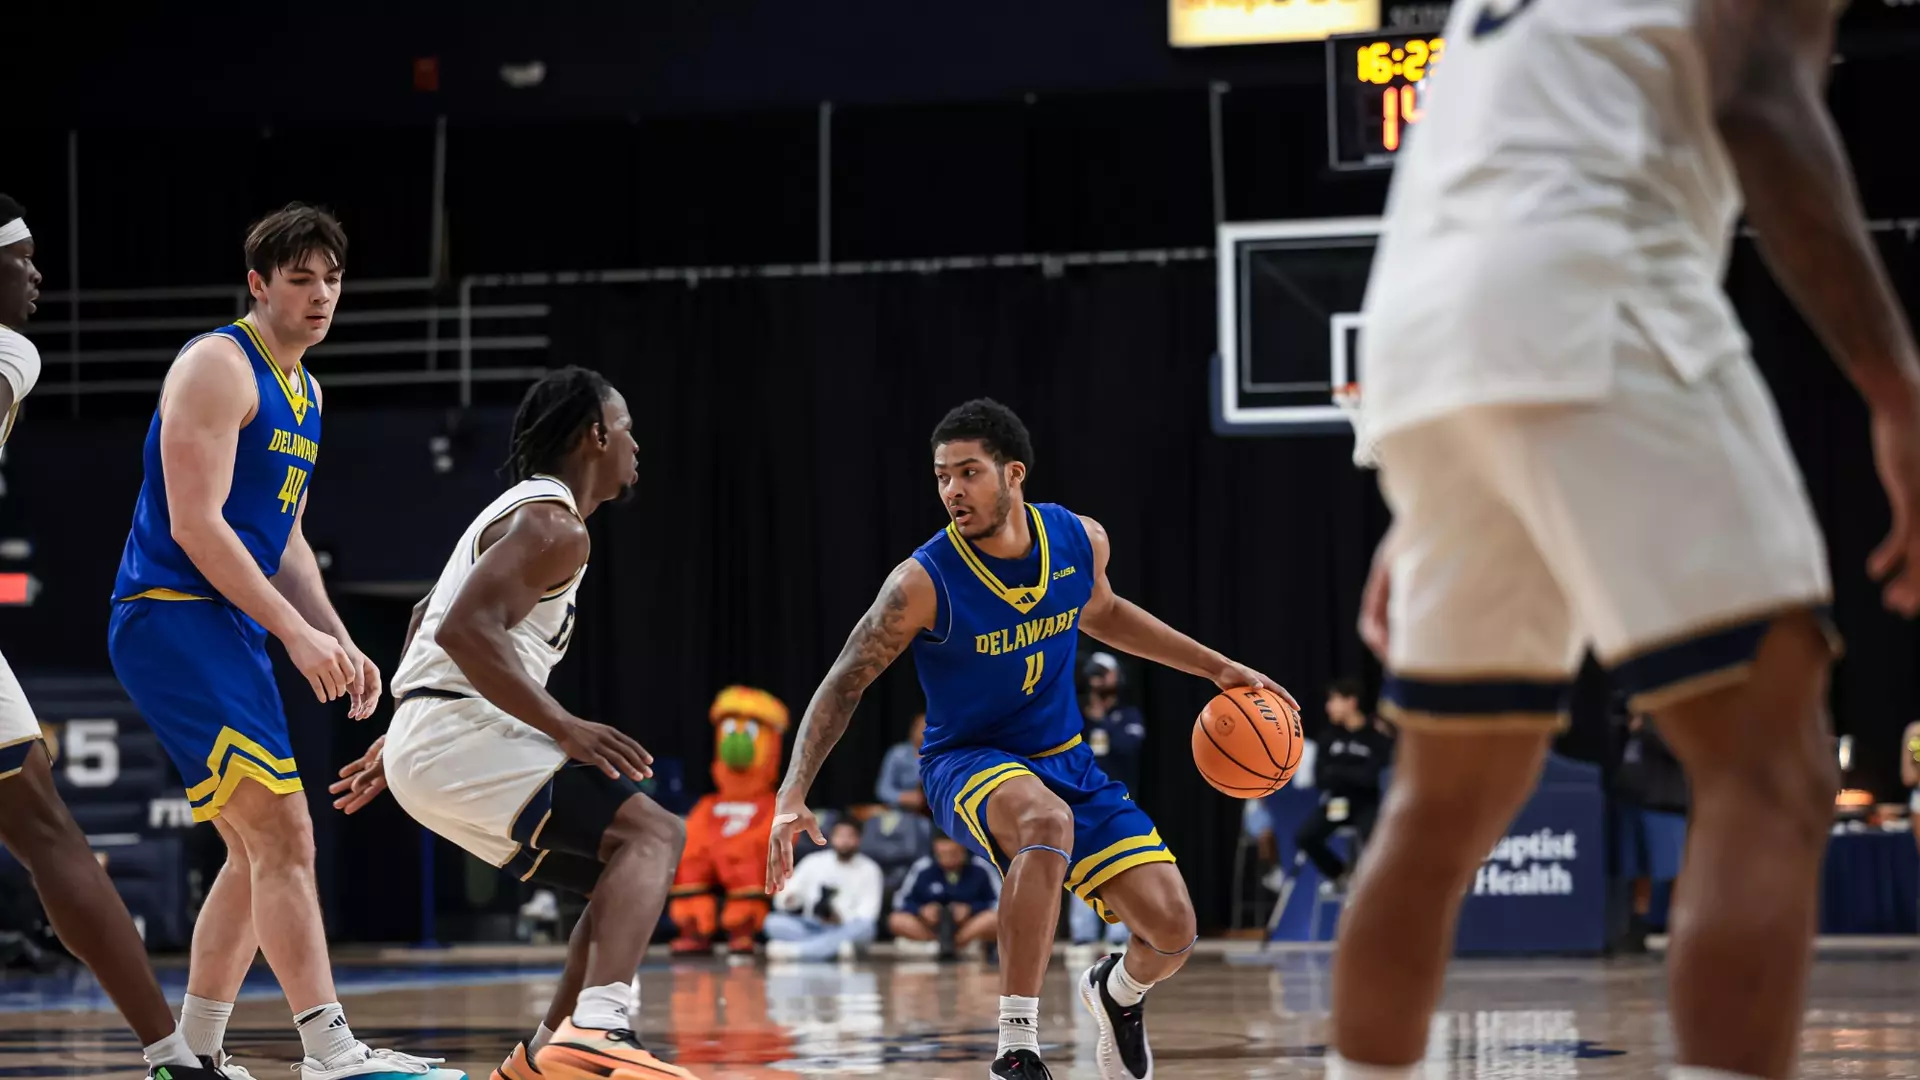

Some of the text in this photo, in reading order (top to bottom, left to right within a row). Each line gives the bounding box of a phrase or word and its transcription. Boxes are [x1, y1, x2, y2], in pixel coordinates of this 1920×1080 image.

[267, 428, 319, 466] DELAWAR
[277, 465, 308, 516] 44
[975, 607, 1079, 656] DELAWARE
[1021, 651, 1045, 695] 4
[1487, 828, 1577, 868] aptist
[1475, 862, 1573, 896] Health
